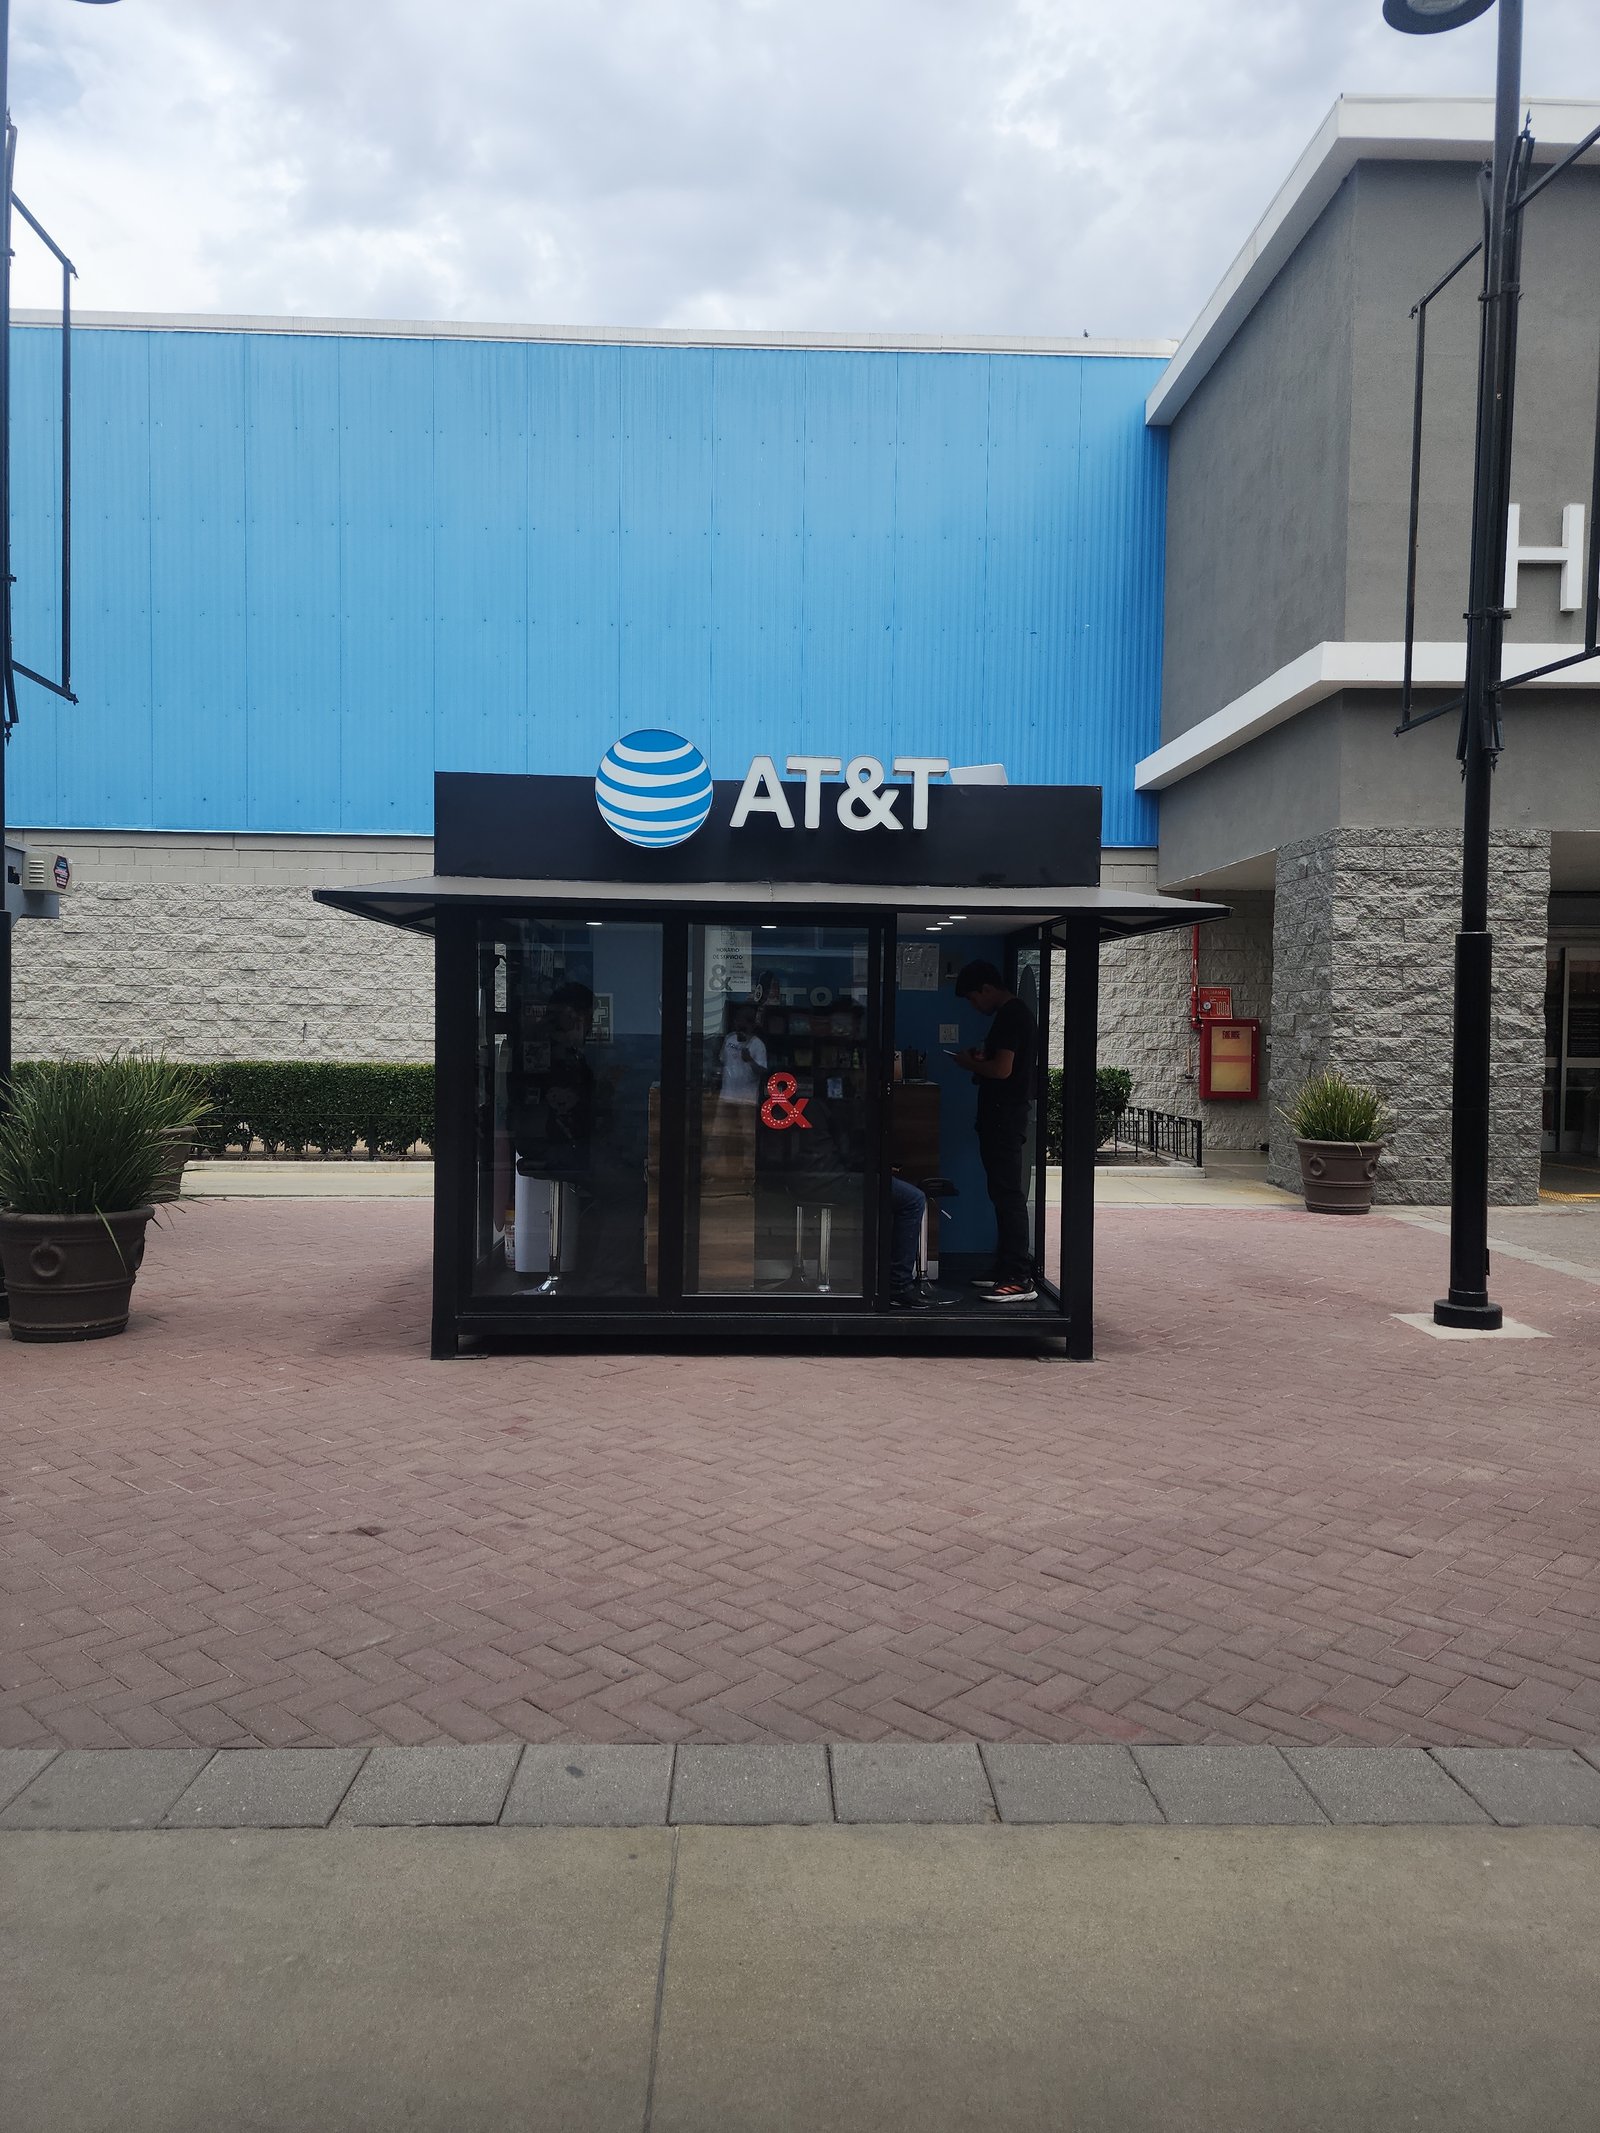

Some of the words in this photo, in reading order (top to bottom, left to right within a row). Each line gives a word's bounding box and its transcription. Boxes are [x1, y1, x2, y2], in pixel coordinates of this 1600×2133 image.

[1503, 502, 1600, 611] H
[729, 754, 950, 831] AT&T
[760, 1071, 814, 1130] &
